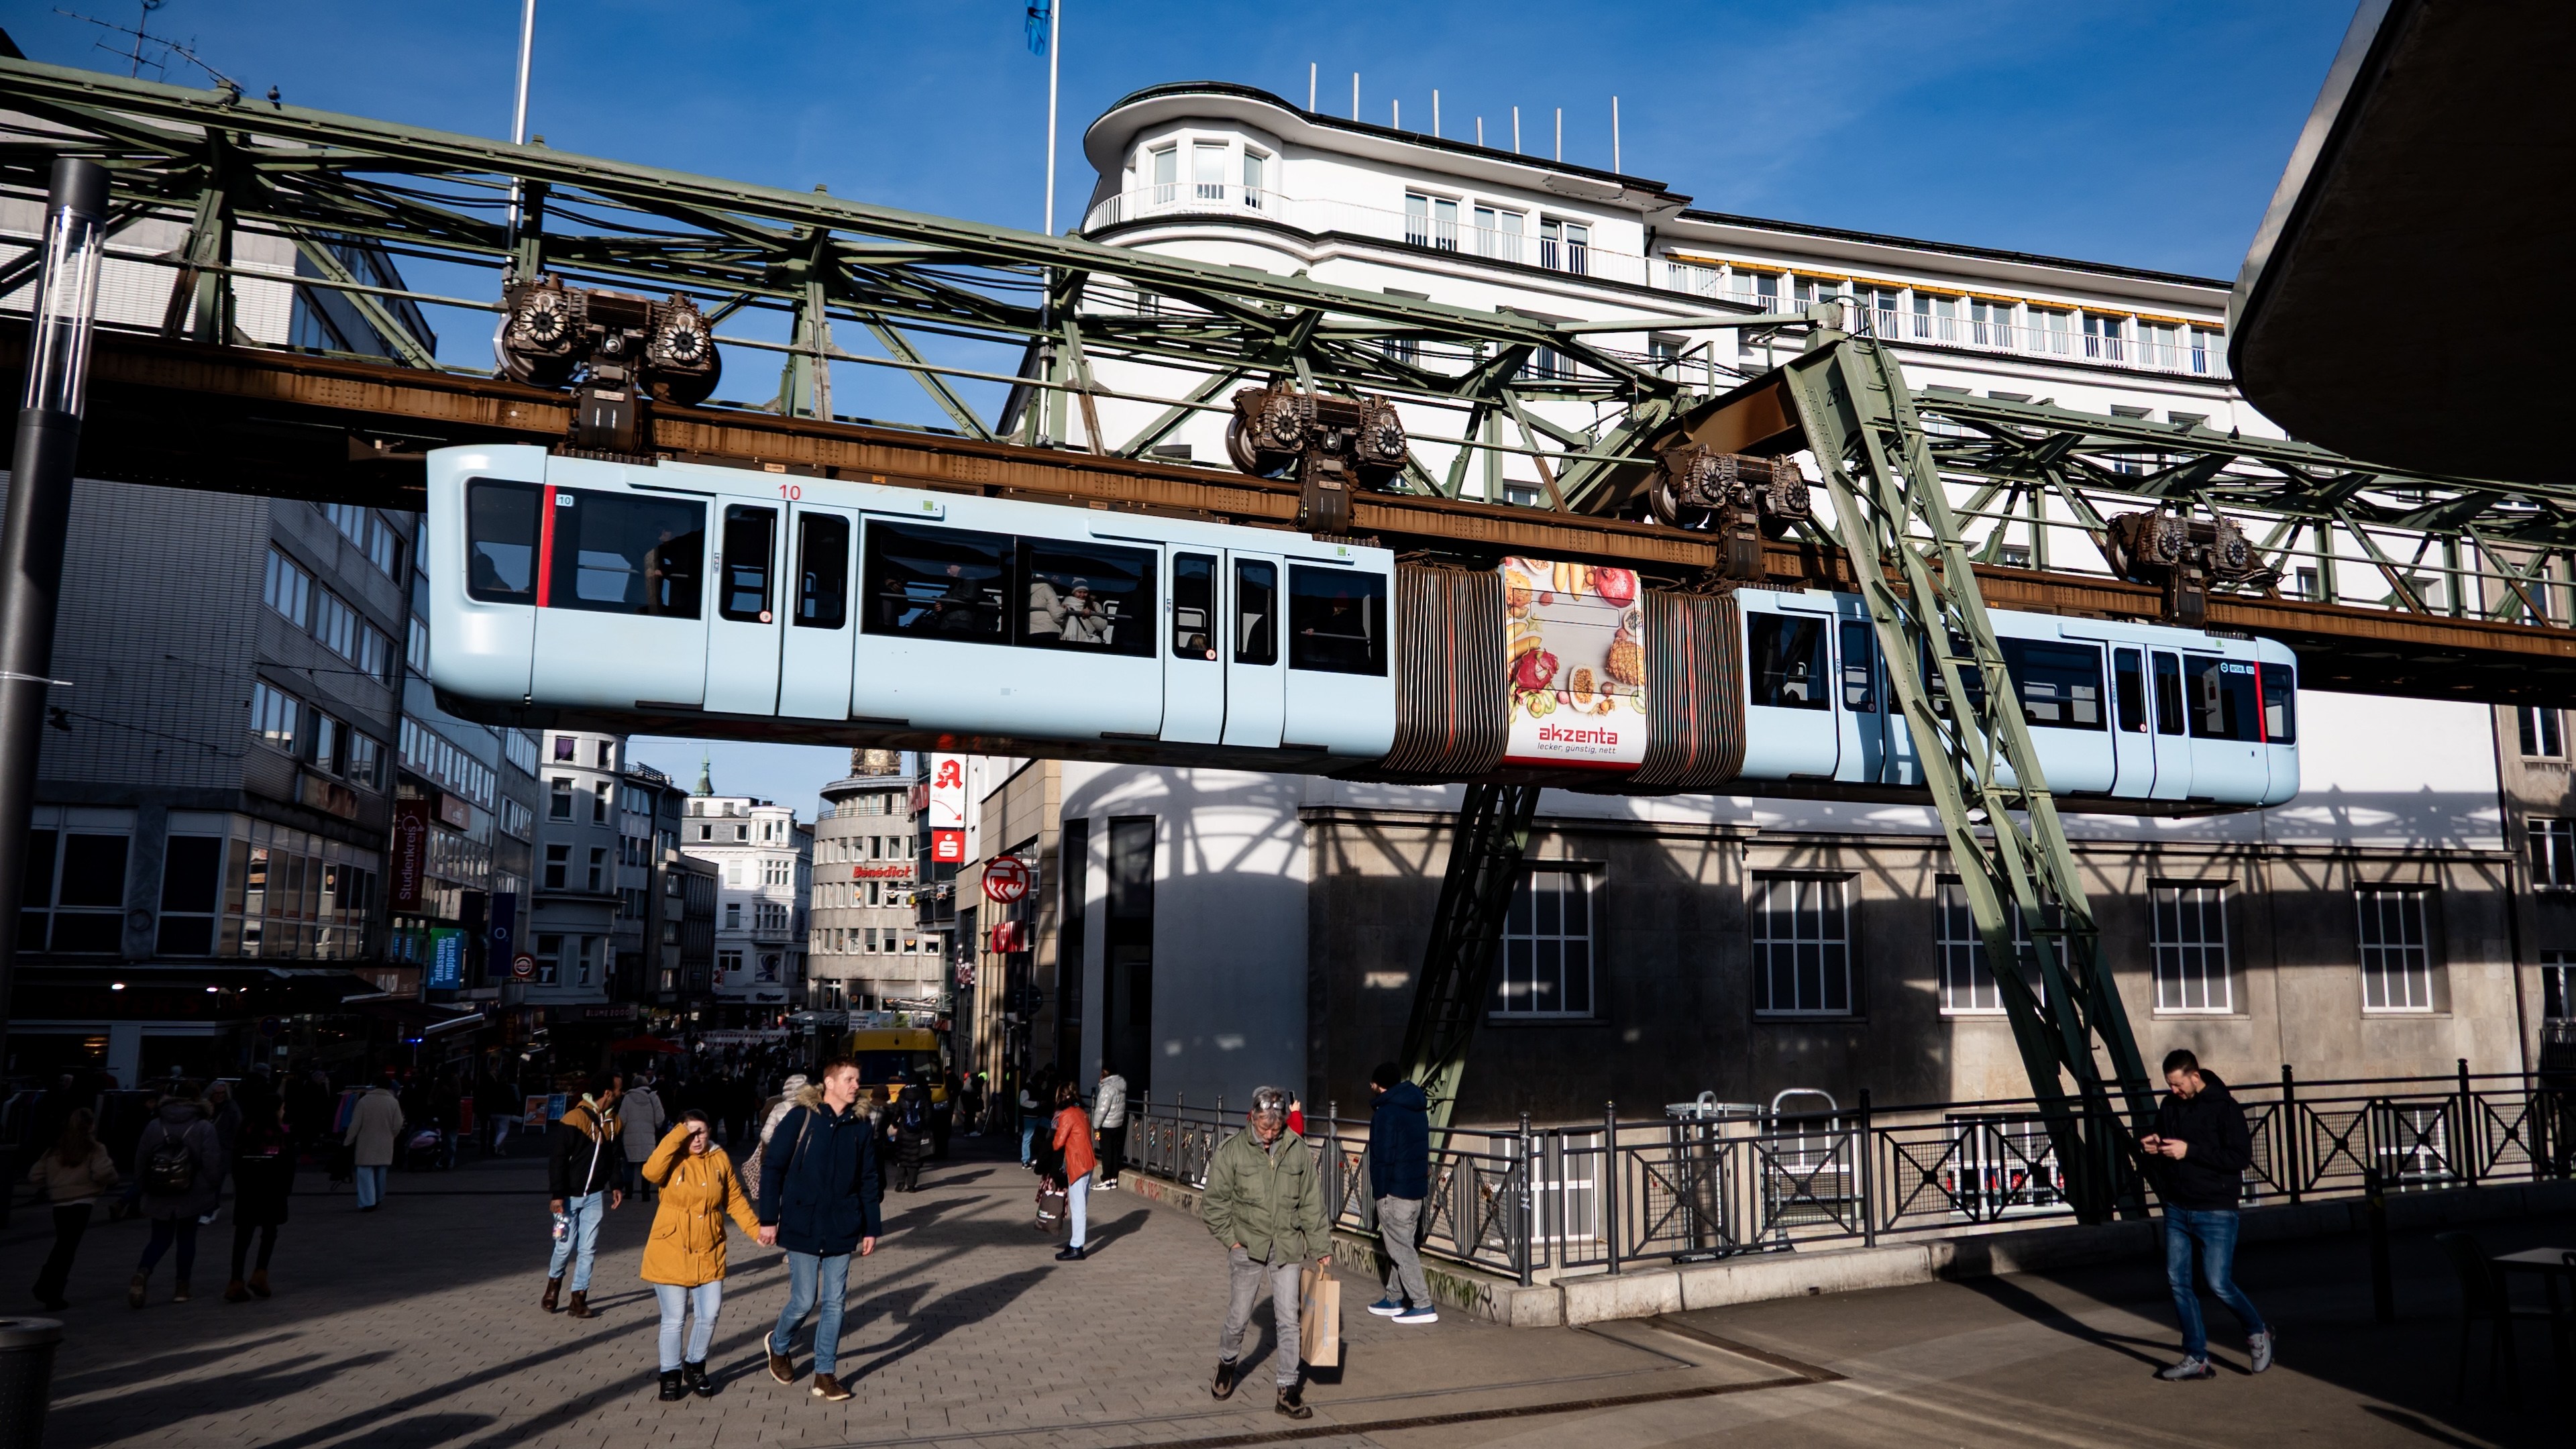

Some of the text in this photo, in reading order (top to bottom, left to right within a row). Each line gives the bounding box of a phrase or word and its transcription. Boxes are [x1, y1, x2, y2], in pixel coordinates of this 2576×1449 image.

[558, 496, 572, 505] 10
[778, 484, 802, 500] 10
[1539, 723, 1617, 745] akzenta
[1537, 742, 1617, 755] lecker, günstig, nett
[398, 826, 417, 900] Studienkreis
[434, 935, 447, 982] zulassung-
[444, 936, 457, 980] wuppertal
